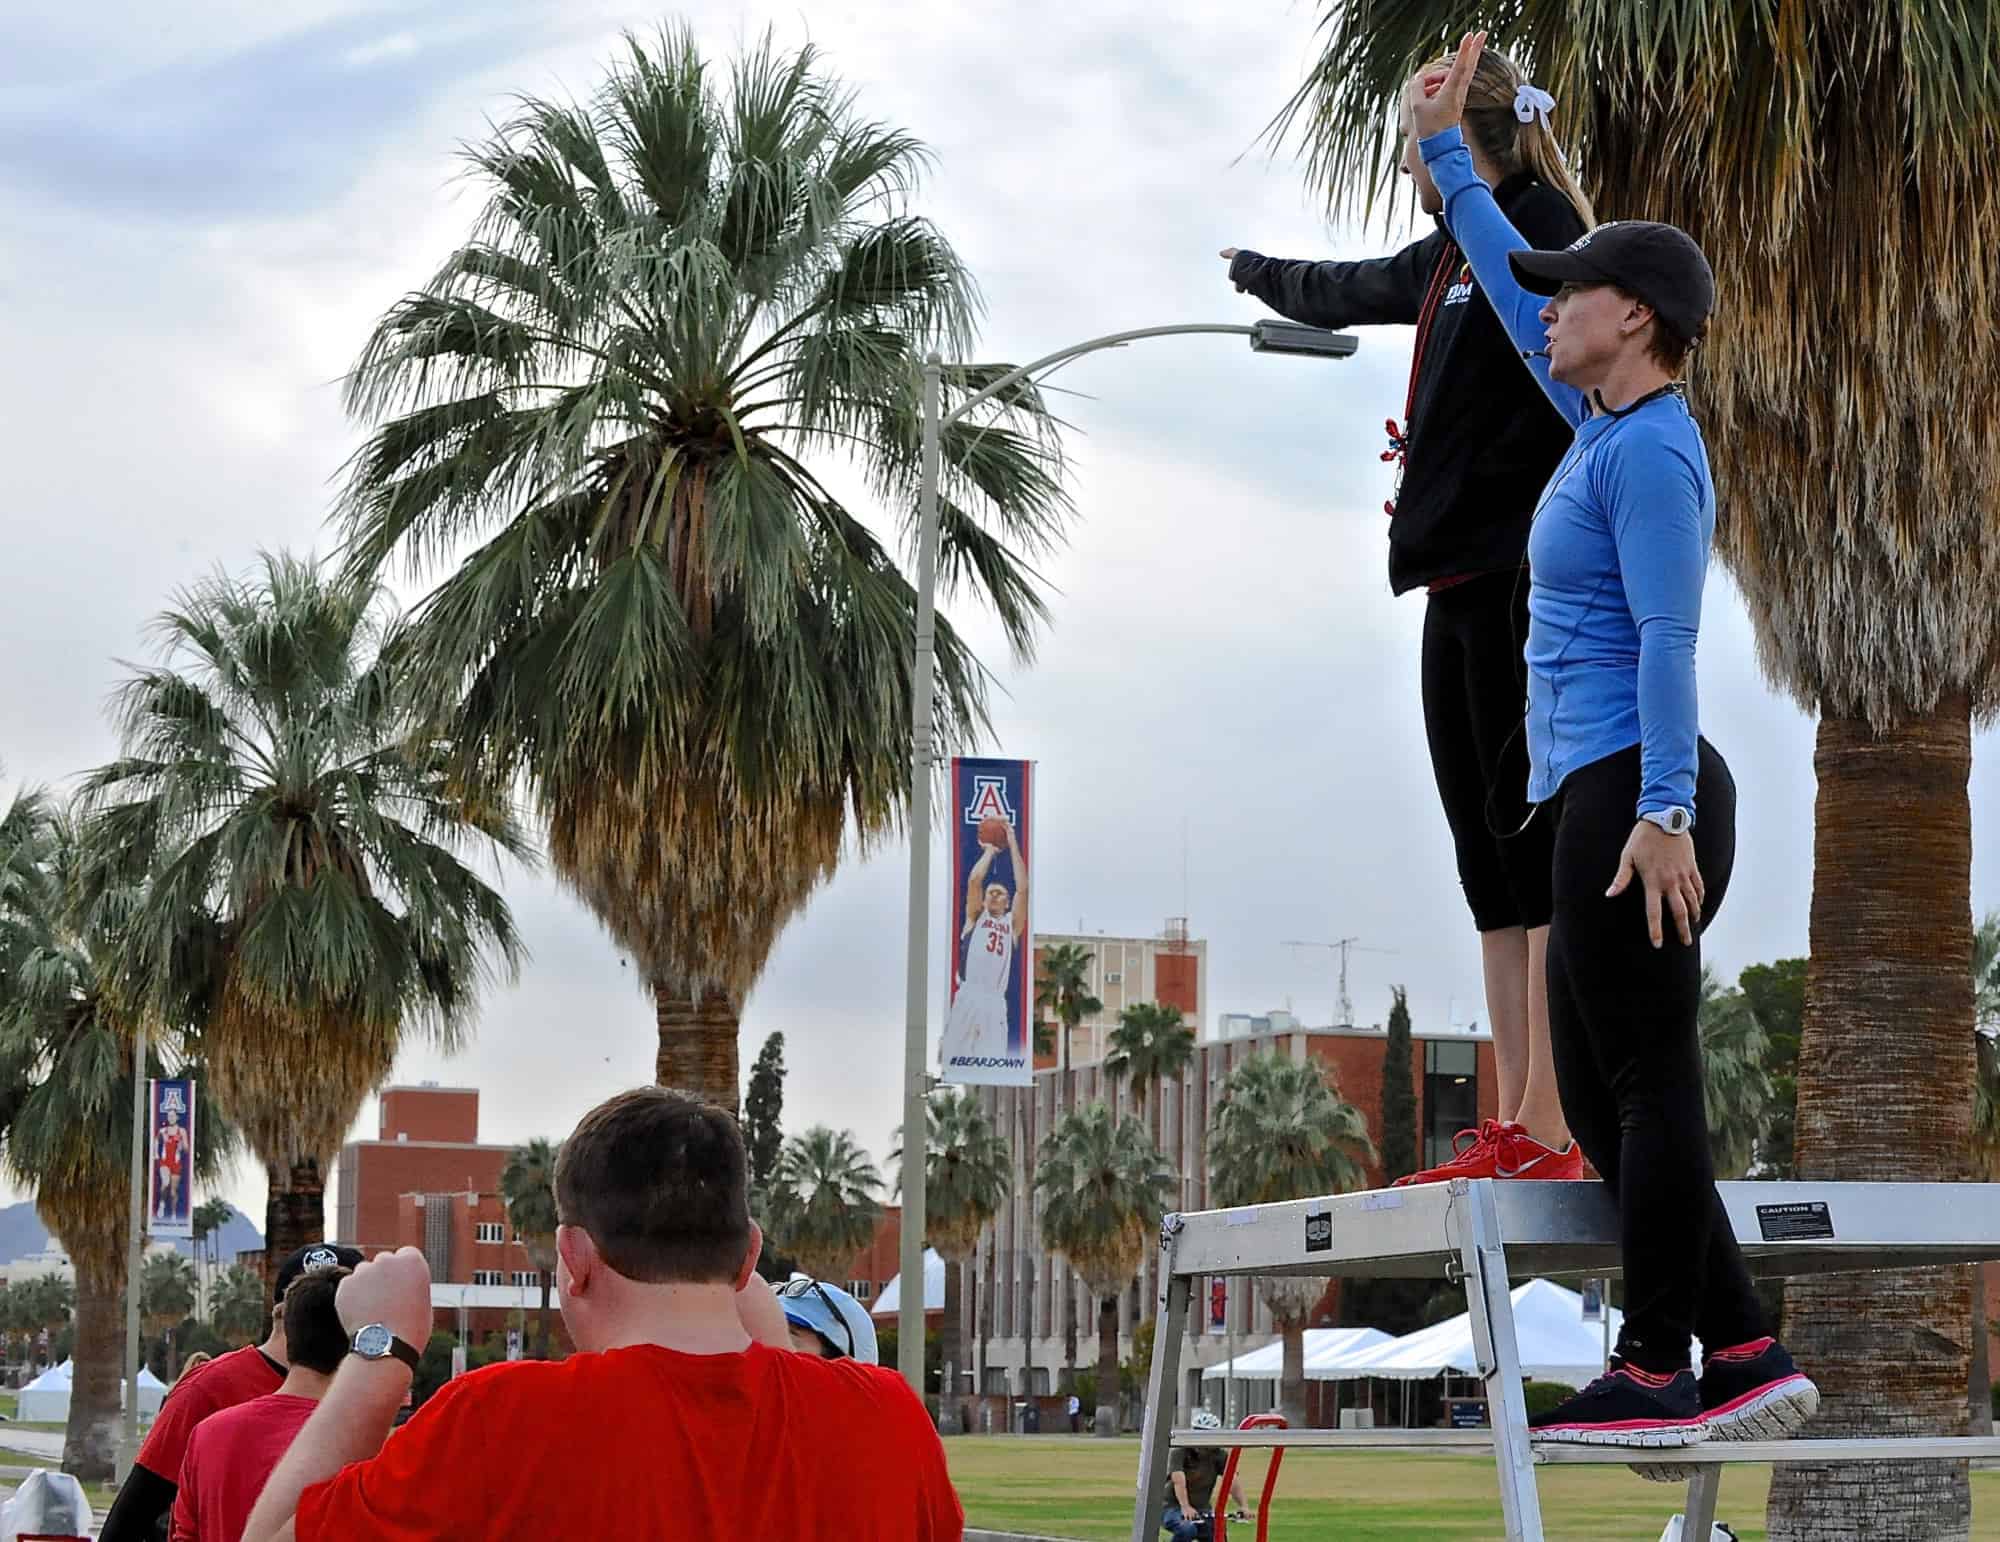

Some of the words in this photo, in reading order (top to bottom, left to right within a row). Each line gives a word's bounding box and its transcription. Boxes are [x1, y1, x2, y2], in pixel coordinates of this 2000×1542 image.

[965, 775, 1016, 826] A
[986, 931, 1004, 956] 35
[949, 1056, 1025, 1069] #BEARDOWN
[160, 1088, 186, 1113] A
[1760, 1206, 1809, 1214] CAUTION
